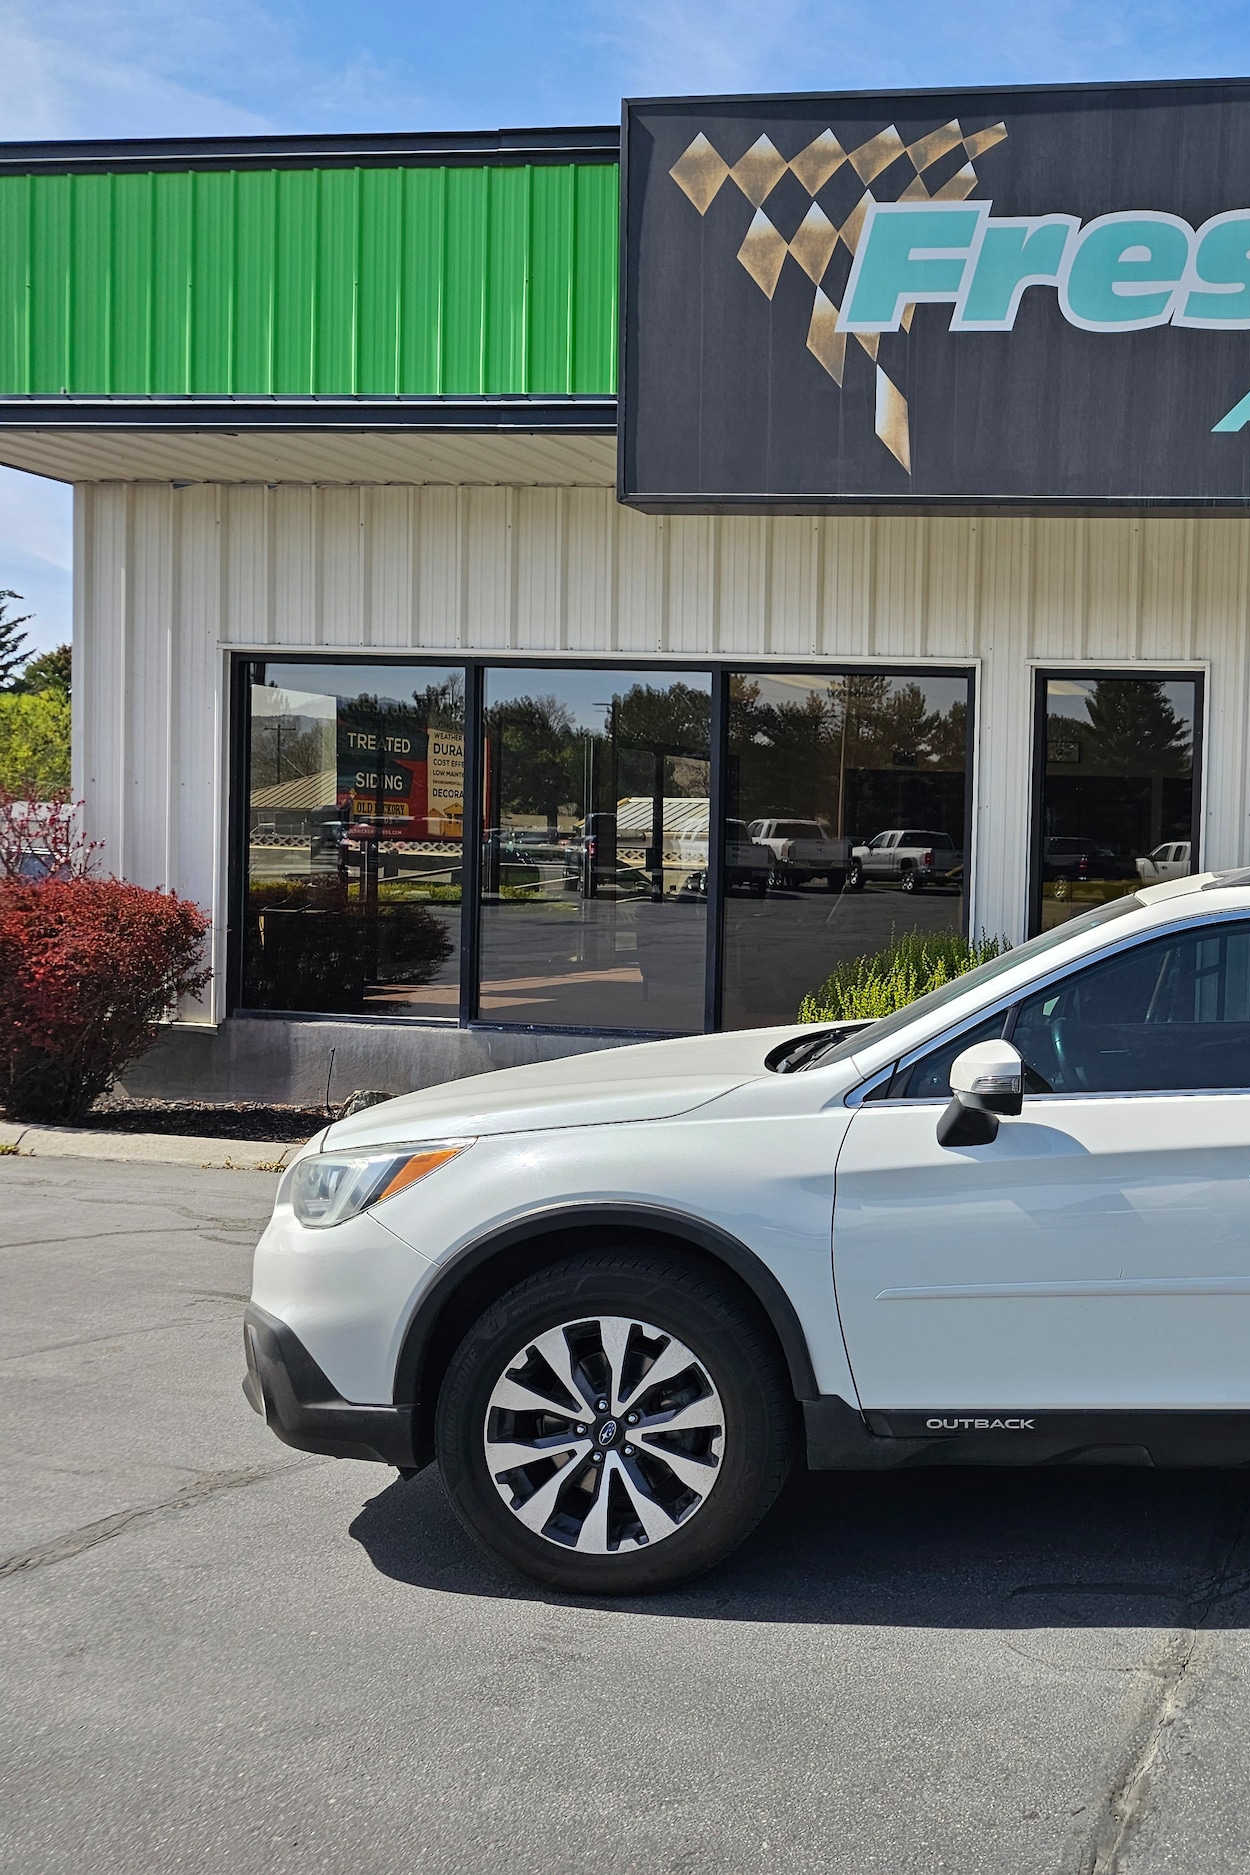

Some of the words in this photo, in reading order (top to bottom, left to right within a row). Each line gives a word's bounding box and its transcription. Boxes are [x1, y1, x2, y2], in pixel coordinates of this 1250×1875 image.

[433, 732, 463, 742] WEATHER
[433, 758, 450, 767] COST
[357, 802, 373, 814] OLD
[374, 803, 405, 816] CKORY
[370, 816, 393, 825] SDS
[925, 1418, 1035, 1430] OUTBACK
